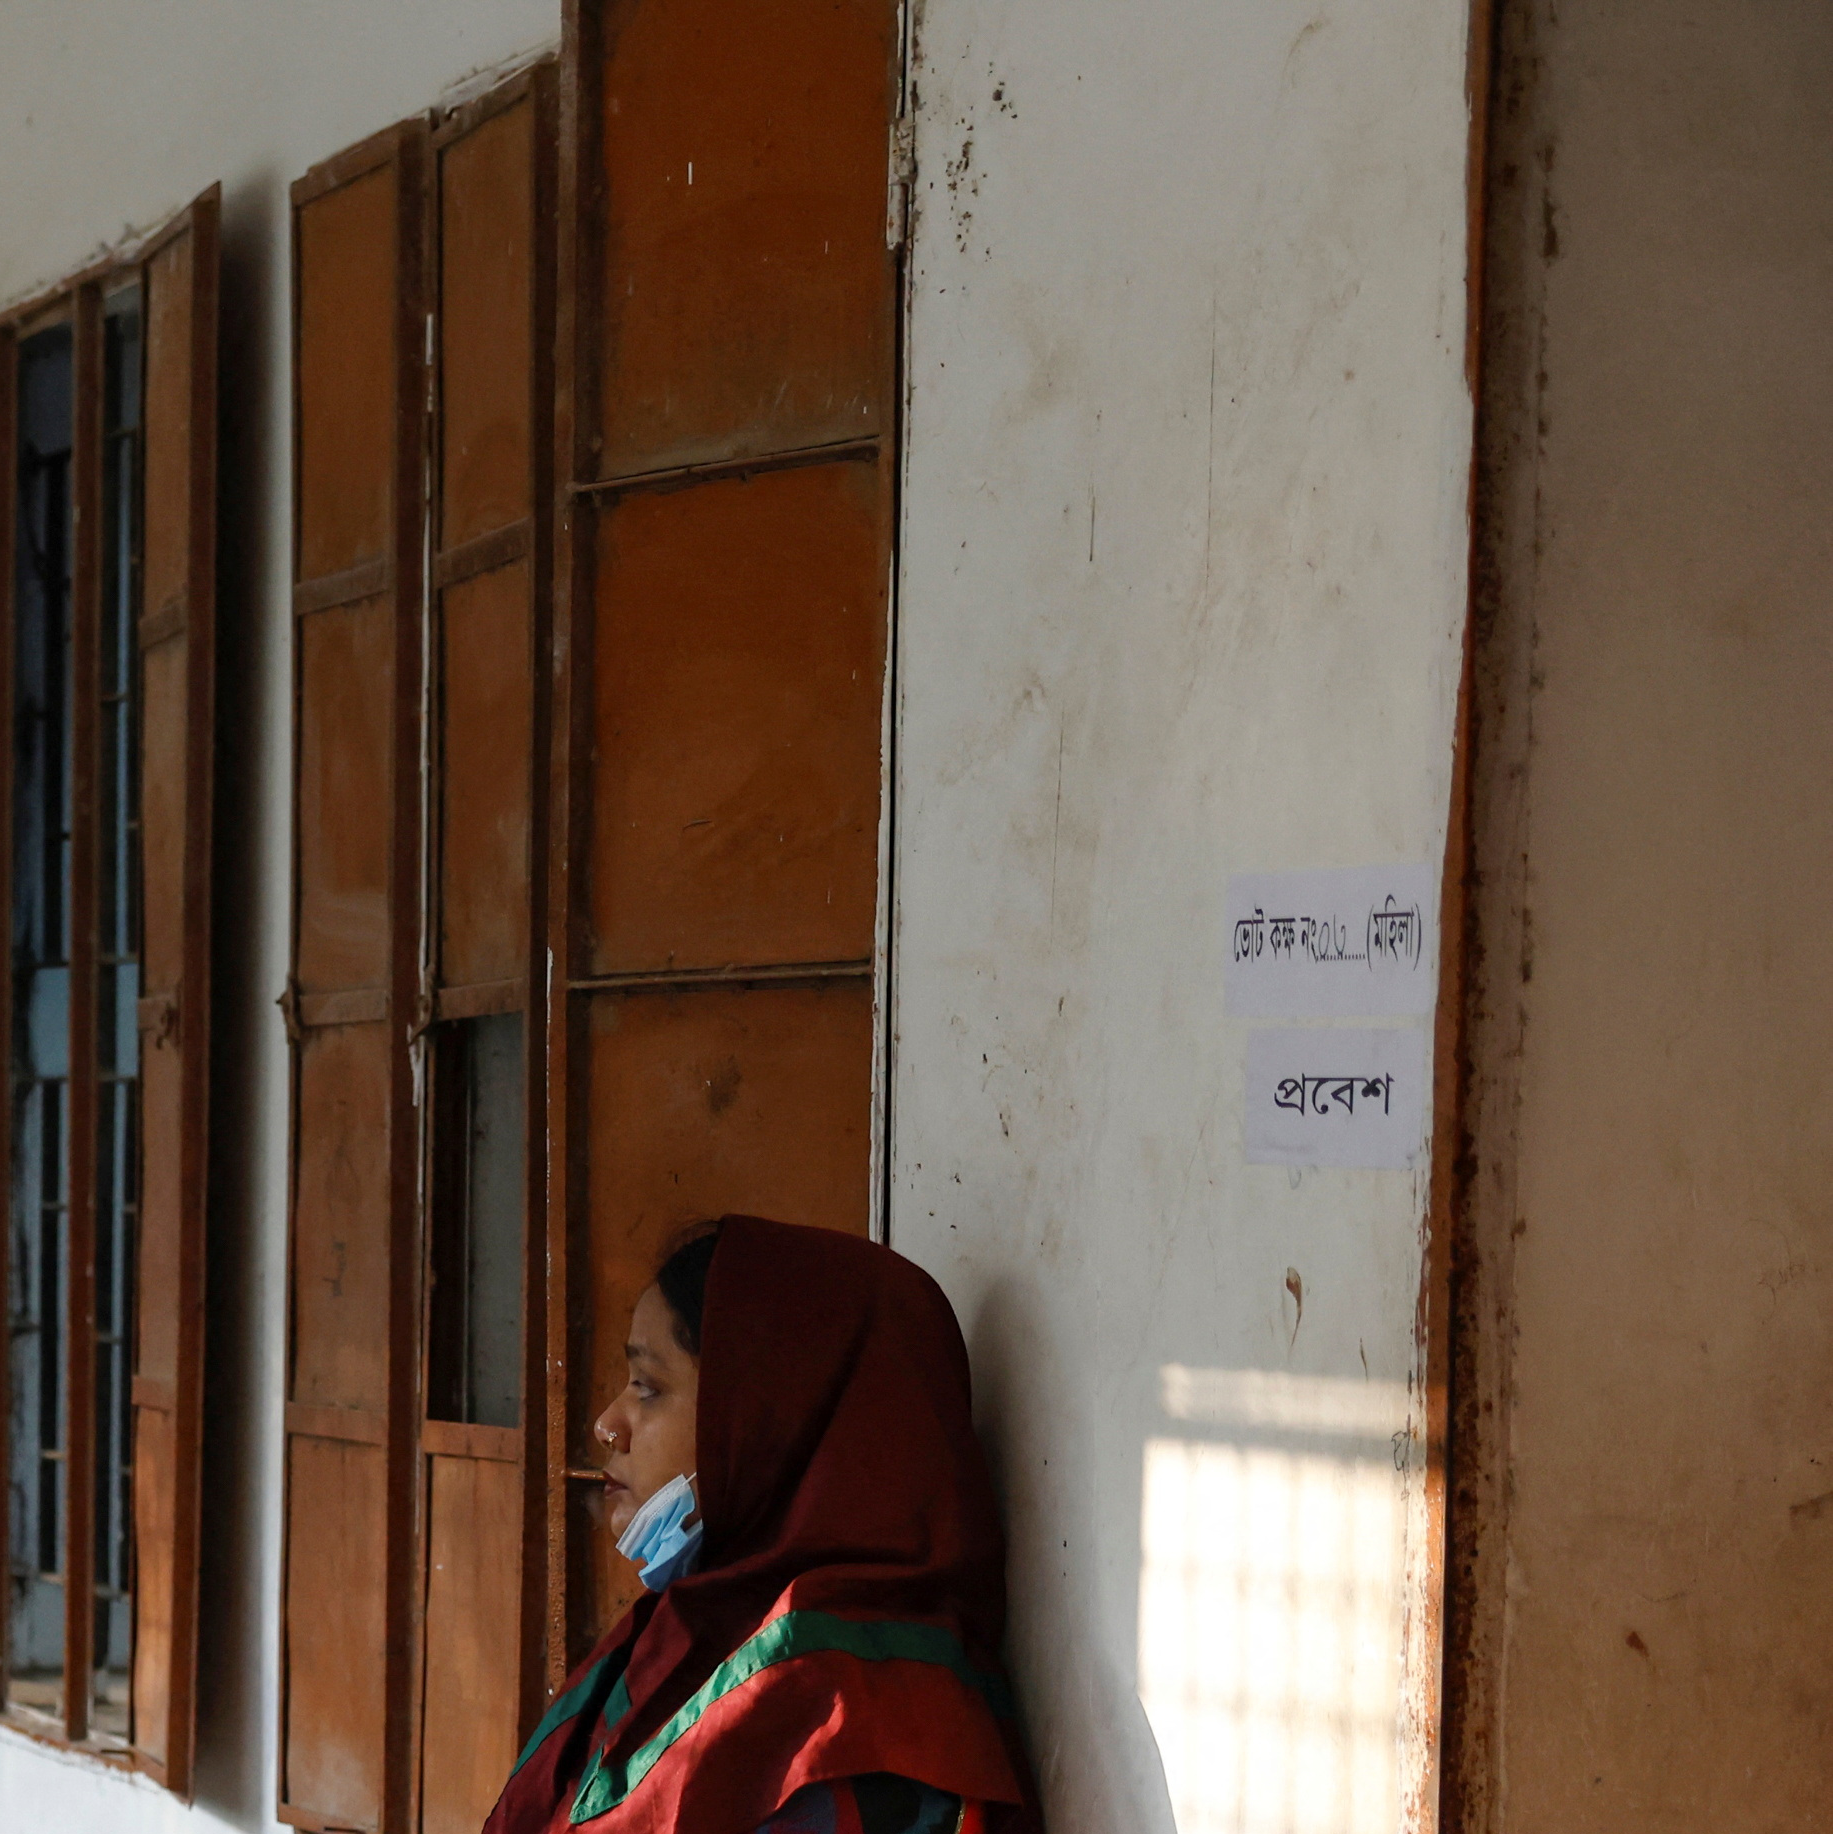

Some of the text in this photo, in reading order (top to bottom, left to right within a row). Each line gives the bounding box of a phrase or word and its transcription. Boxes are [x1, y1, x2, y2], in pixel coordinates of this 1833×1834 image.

[1234, 903, 1265, 962] ভোট
[1269, 917, 1296, 961] কক্ষ
[1367, 893, 1421, 972] (মহিলা)
[1274, 1072, 1395, 1116] প্রবেশ
